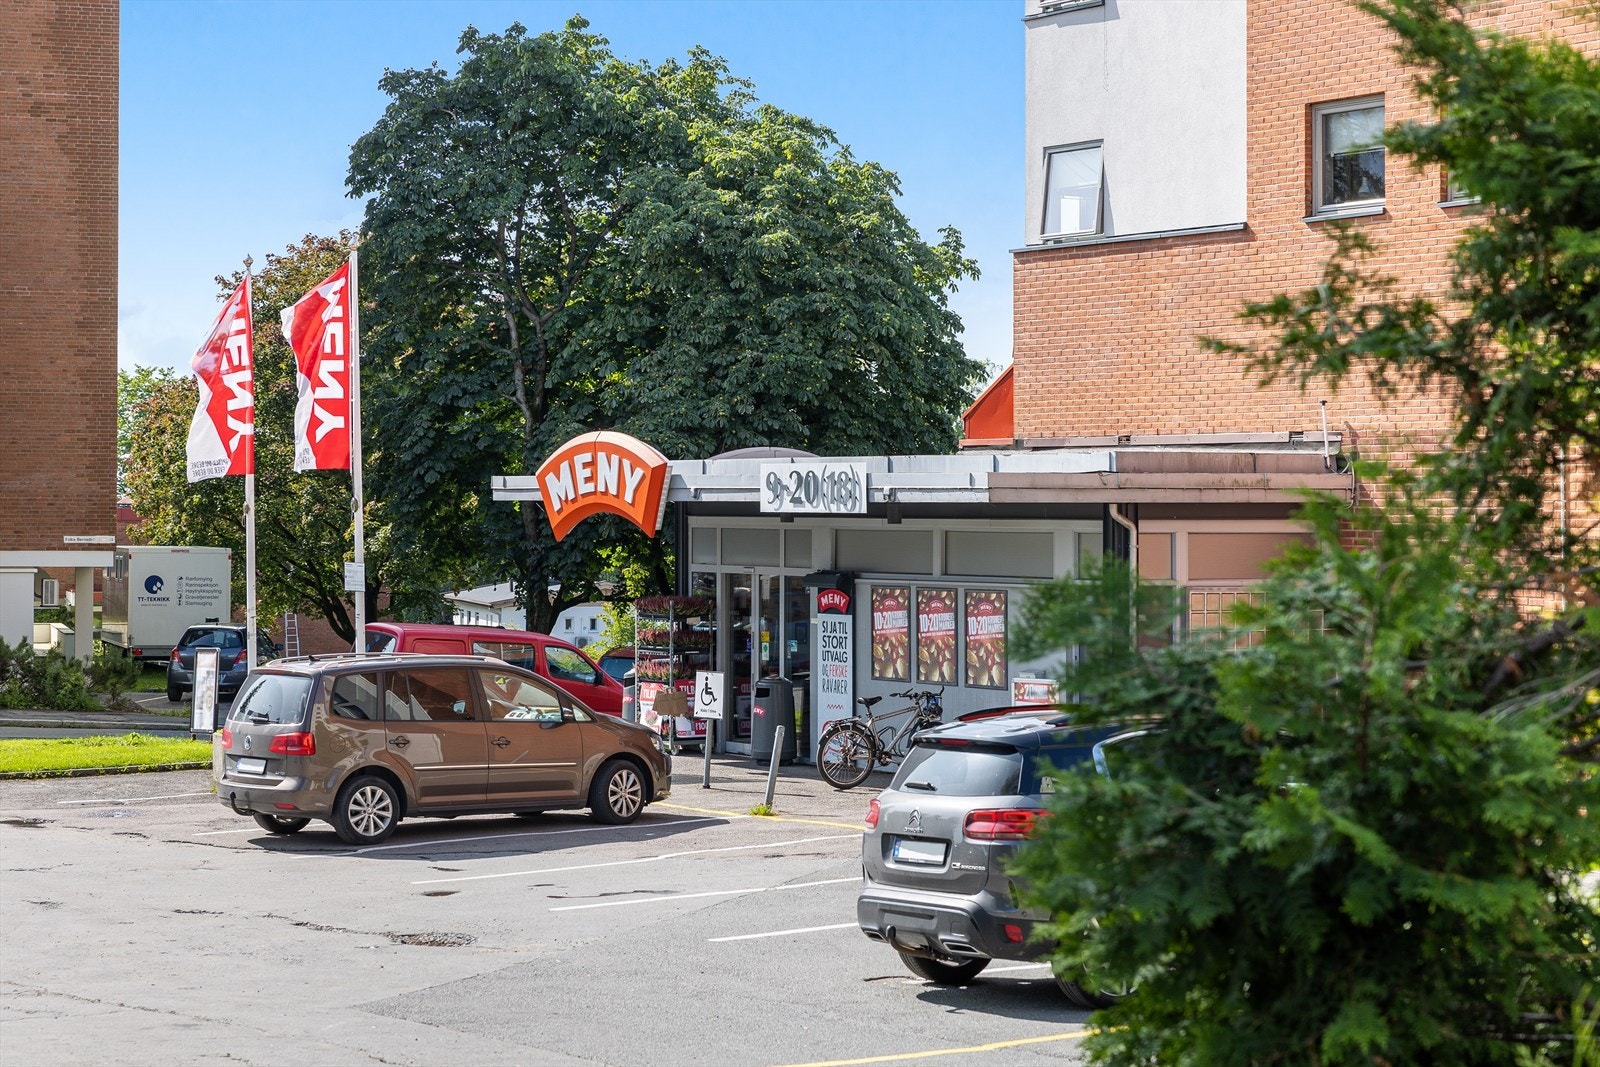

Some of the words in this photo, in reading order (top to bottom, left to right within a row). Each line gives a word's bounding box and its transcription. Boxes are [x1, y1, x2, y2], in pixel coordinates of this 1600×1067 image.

[544, 451, 645, 513] MENY
[764, 464, 860, 511] 9-20(18)
[820, 592, 846, 606] MENY
[822, 620, 828, 633] SI
[829, 621, 838, 634] JA
[838, 622, 847, 634] TIL
[822, 635, 848, 649] STORT
[822, 650, 848, 663] UTVALG
[679, 686, 695, 695] TILB
